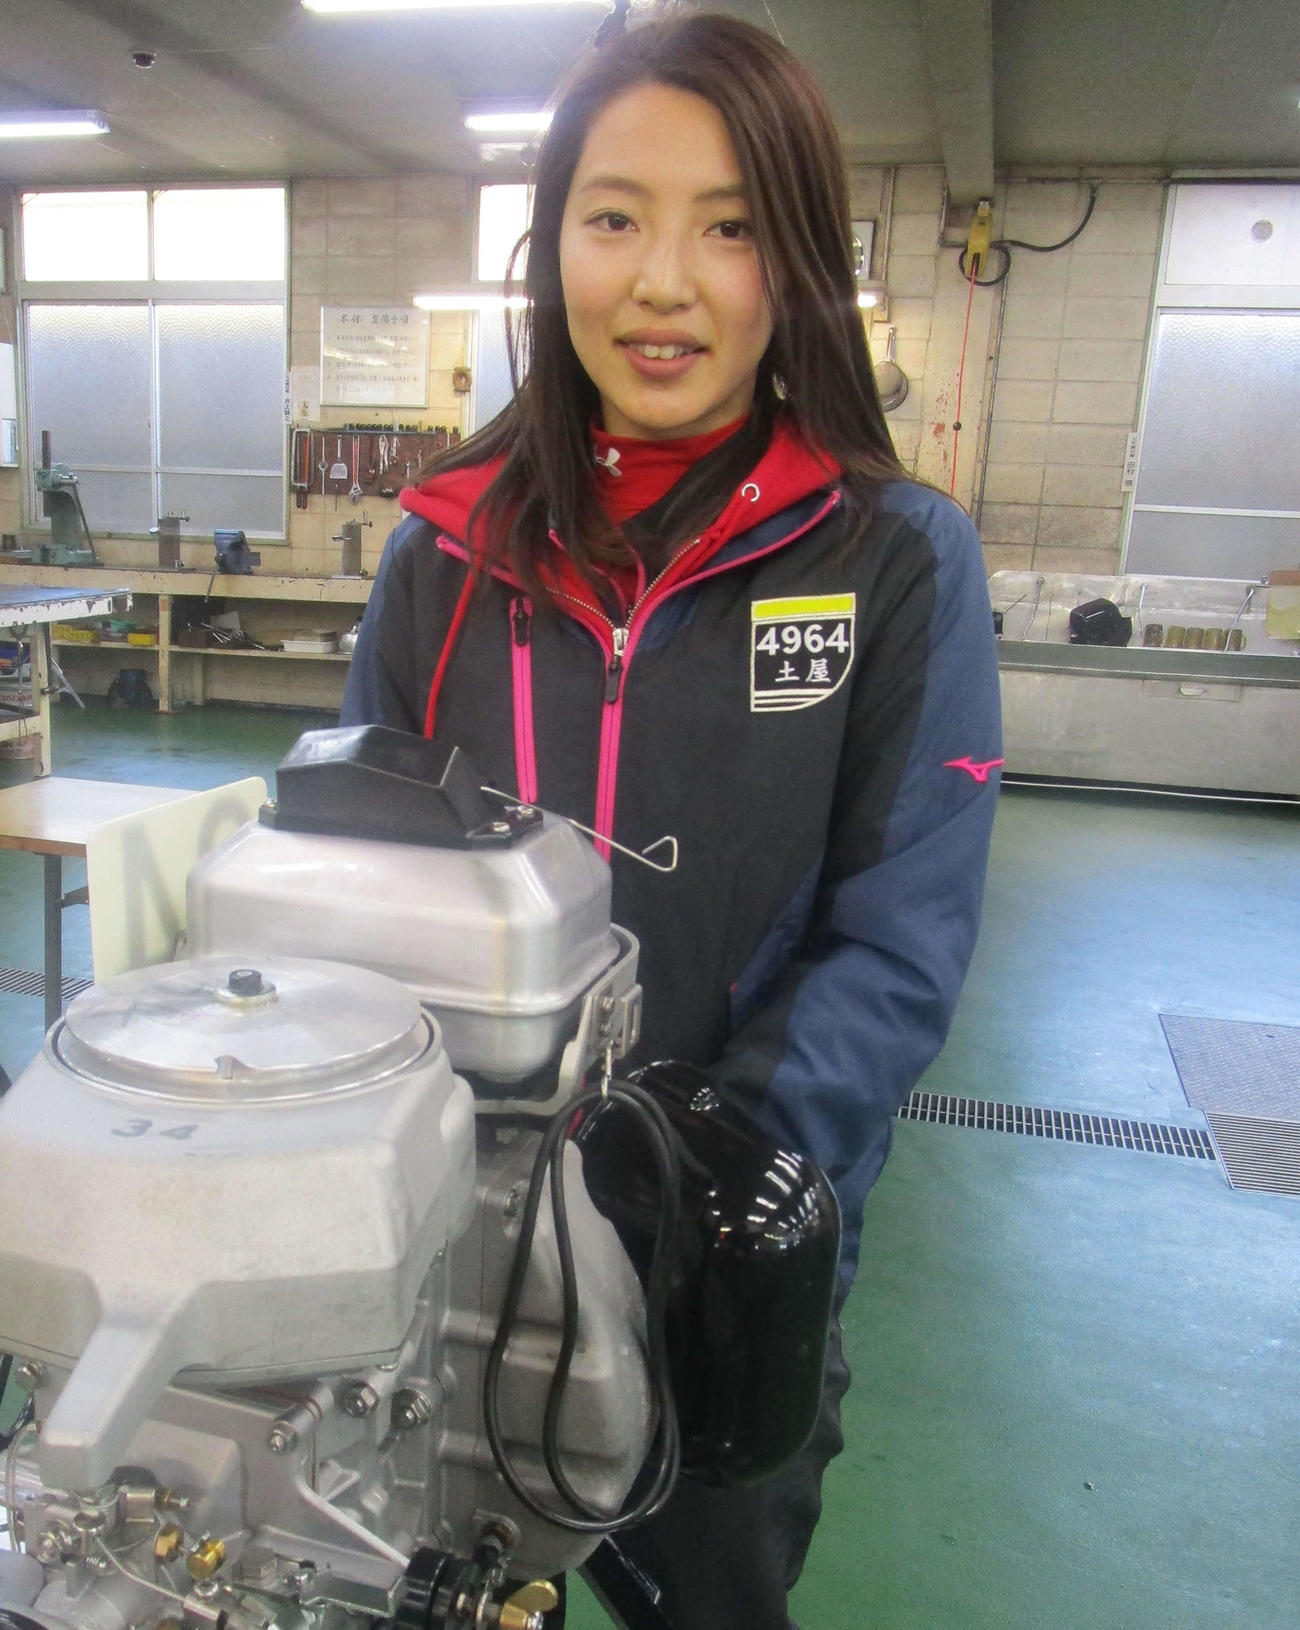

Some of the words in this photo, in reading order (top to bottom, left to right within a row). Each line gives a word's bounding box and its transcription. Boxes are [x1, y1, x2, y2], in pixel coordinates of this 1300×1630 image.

[756, 622, 850, 656] 4964
[774, 657, 832, 683] 土屋
[110, 1118, 198, 1141] 34
